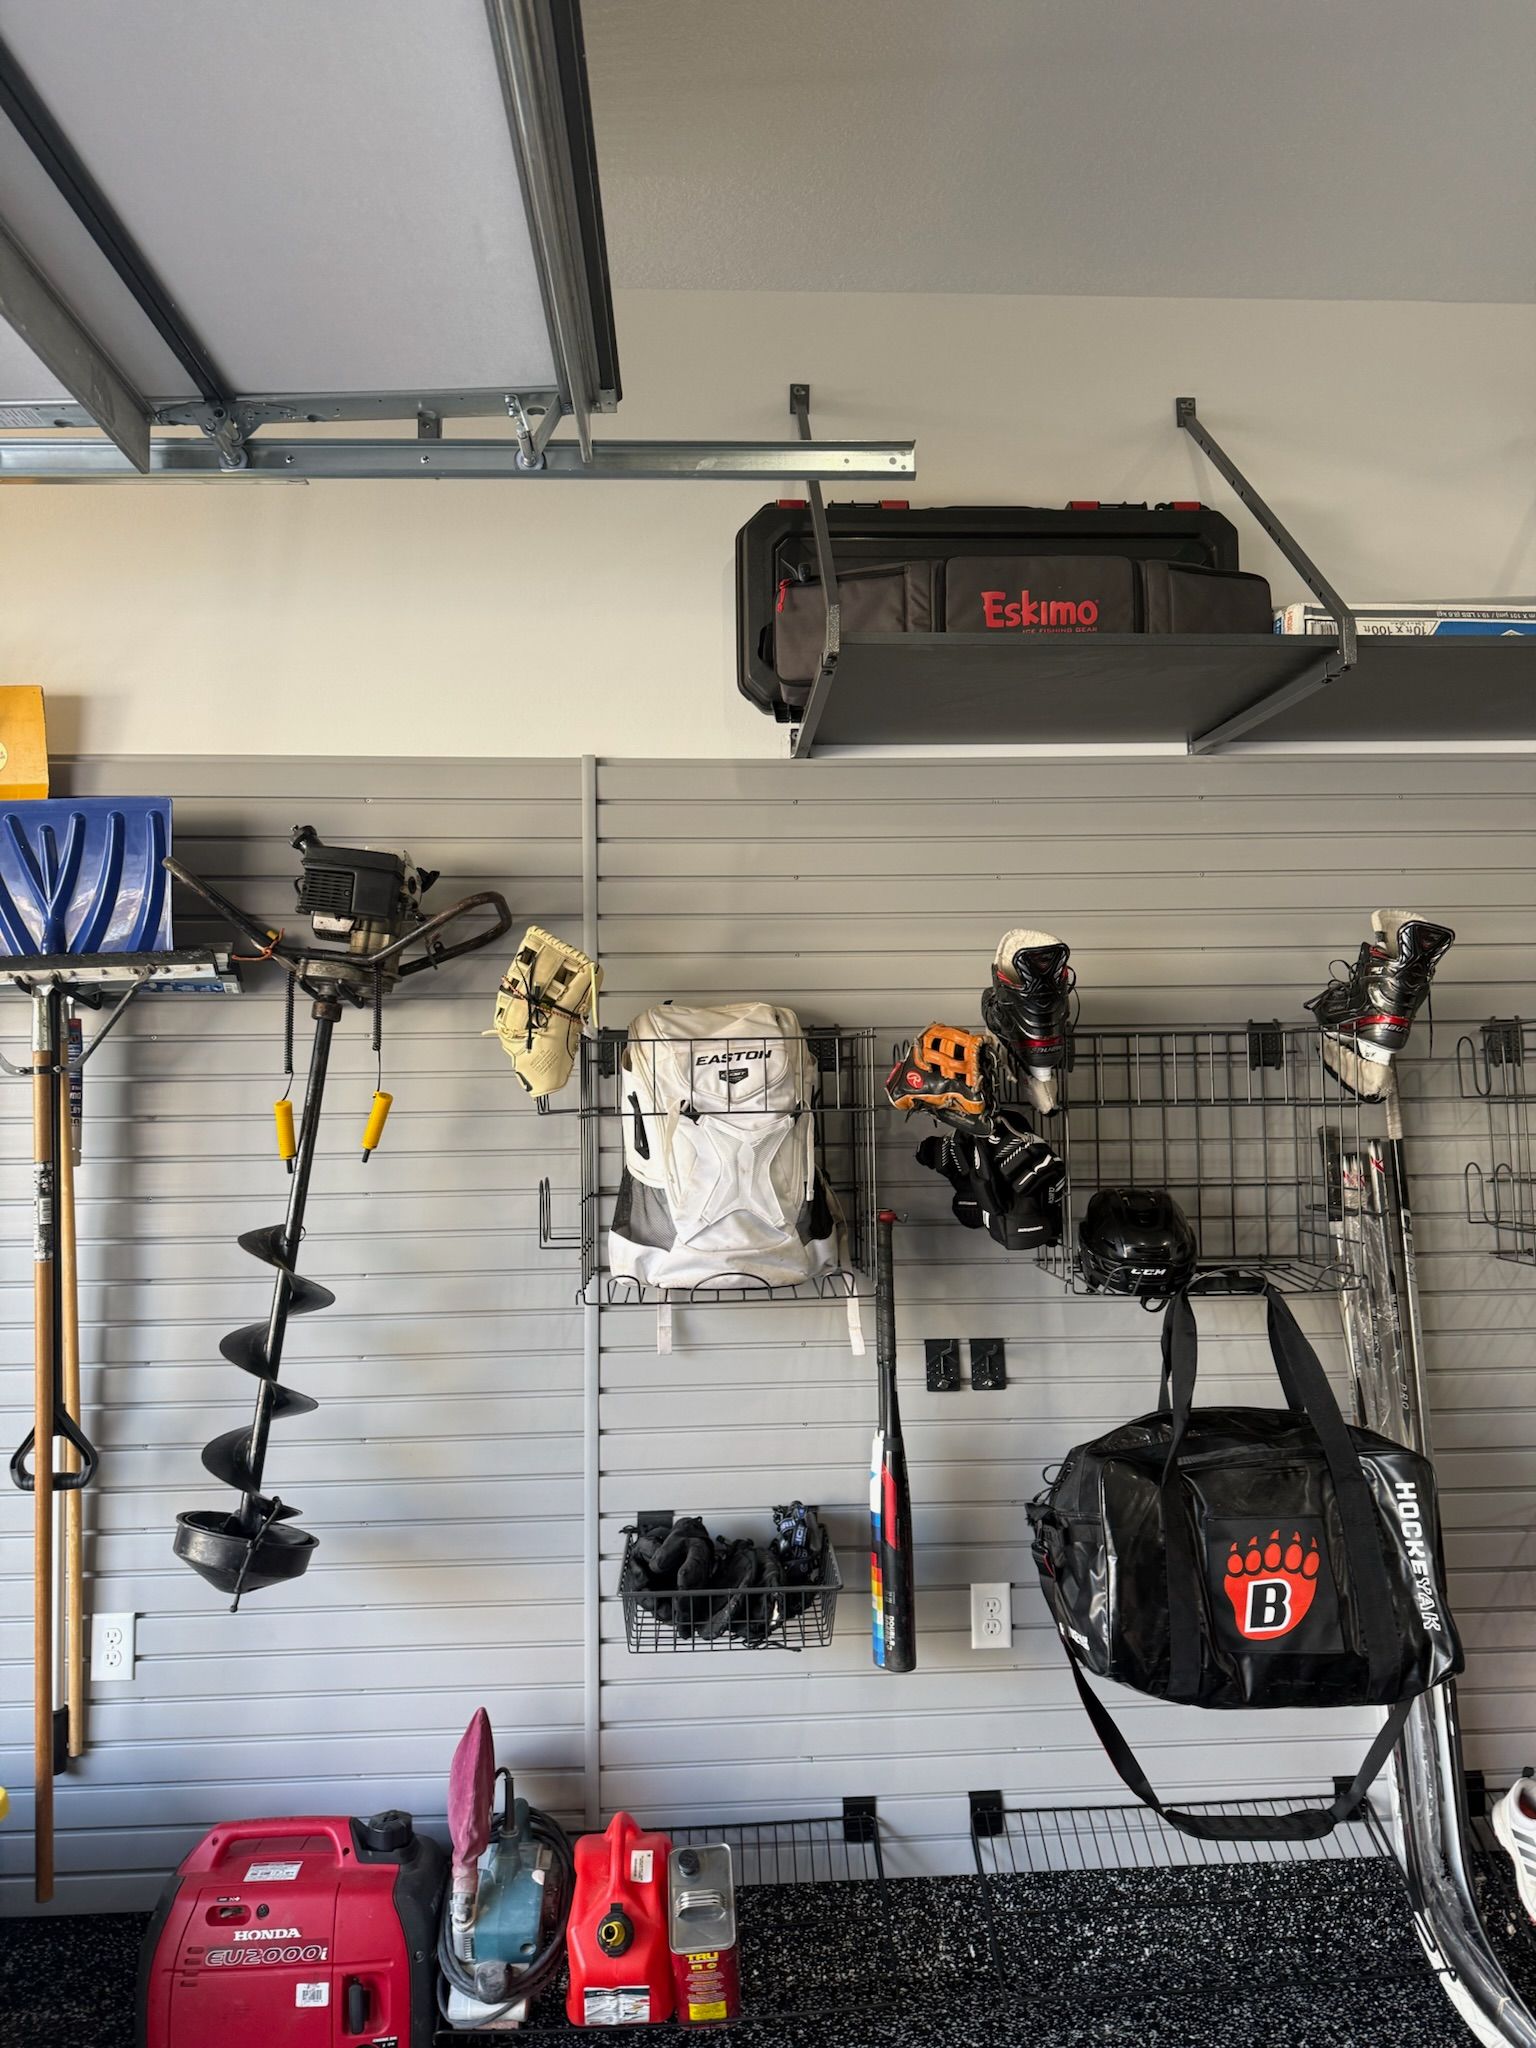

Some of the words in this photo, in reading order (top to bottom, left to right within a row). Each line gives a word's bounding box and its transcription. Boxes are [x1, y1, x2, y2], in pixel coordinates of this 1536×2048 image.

[981, 590, 1098, 628] Eskimo
[696, 1050, 772, 1066] EASTON
[1131, 1268, 1167, 1276] CCM
[1399, 1382, 1410, 1410] PRO
[1244, 1578, 1292, 1633] B
[233, 1928, 301, 1941] HONDA
[205, 1945, 328, 1967] EU2000i
[685, 1952, 719, 1961] TRU
